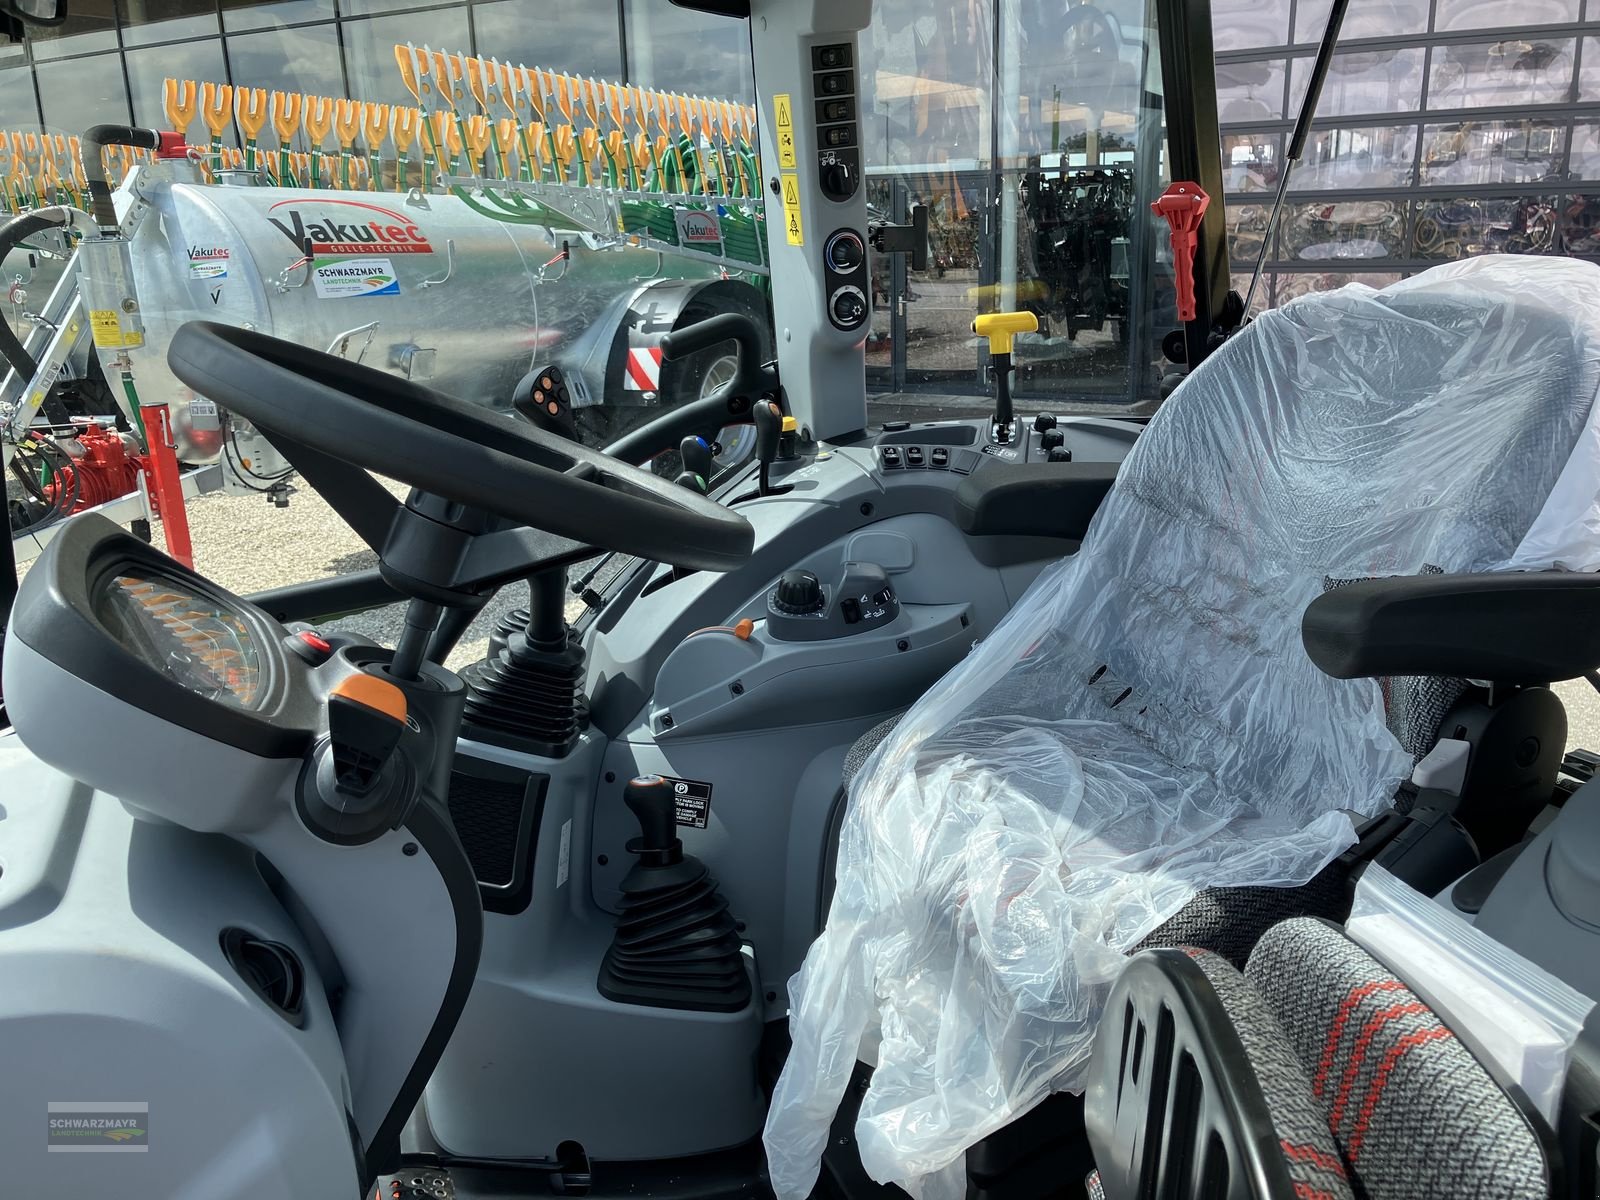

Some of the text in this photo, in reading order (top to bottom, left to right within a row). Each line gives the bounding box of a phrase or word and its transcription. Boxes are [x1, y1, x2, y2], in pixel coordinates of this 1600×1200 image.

[267, 210, 427, 254] Vakutec
[682, 220, 718, 240] Vakutec
[187, 245, 229, 260] Vakutec
[318, 267, 384, 278] SCHWARZMAYR
